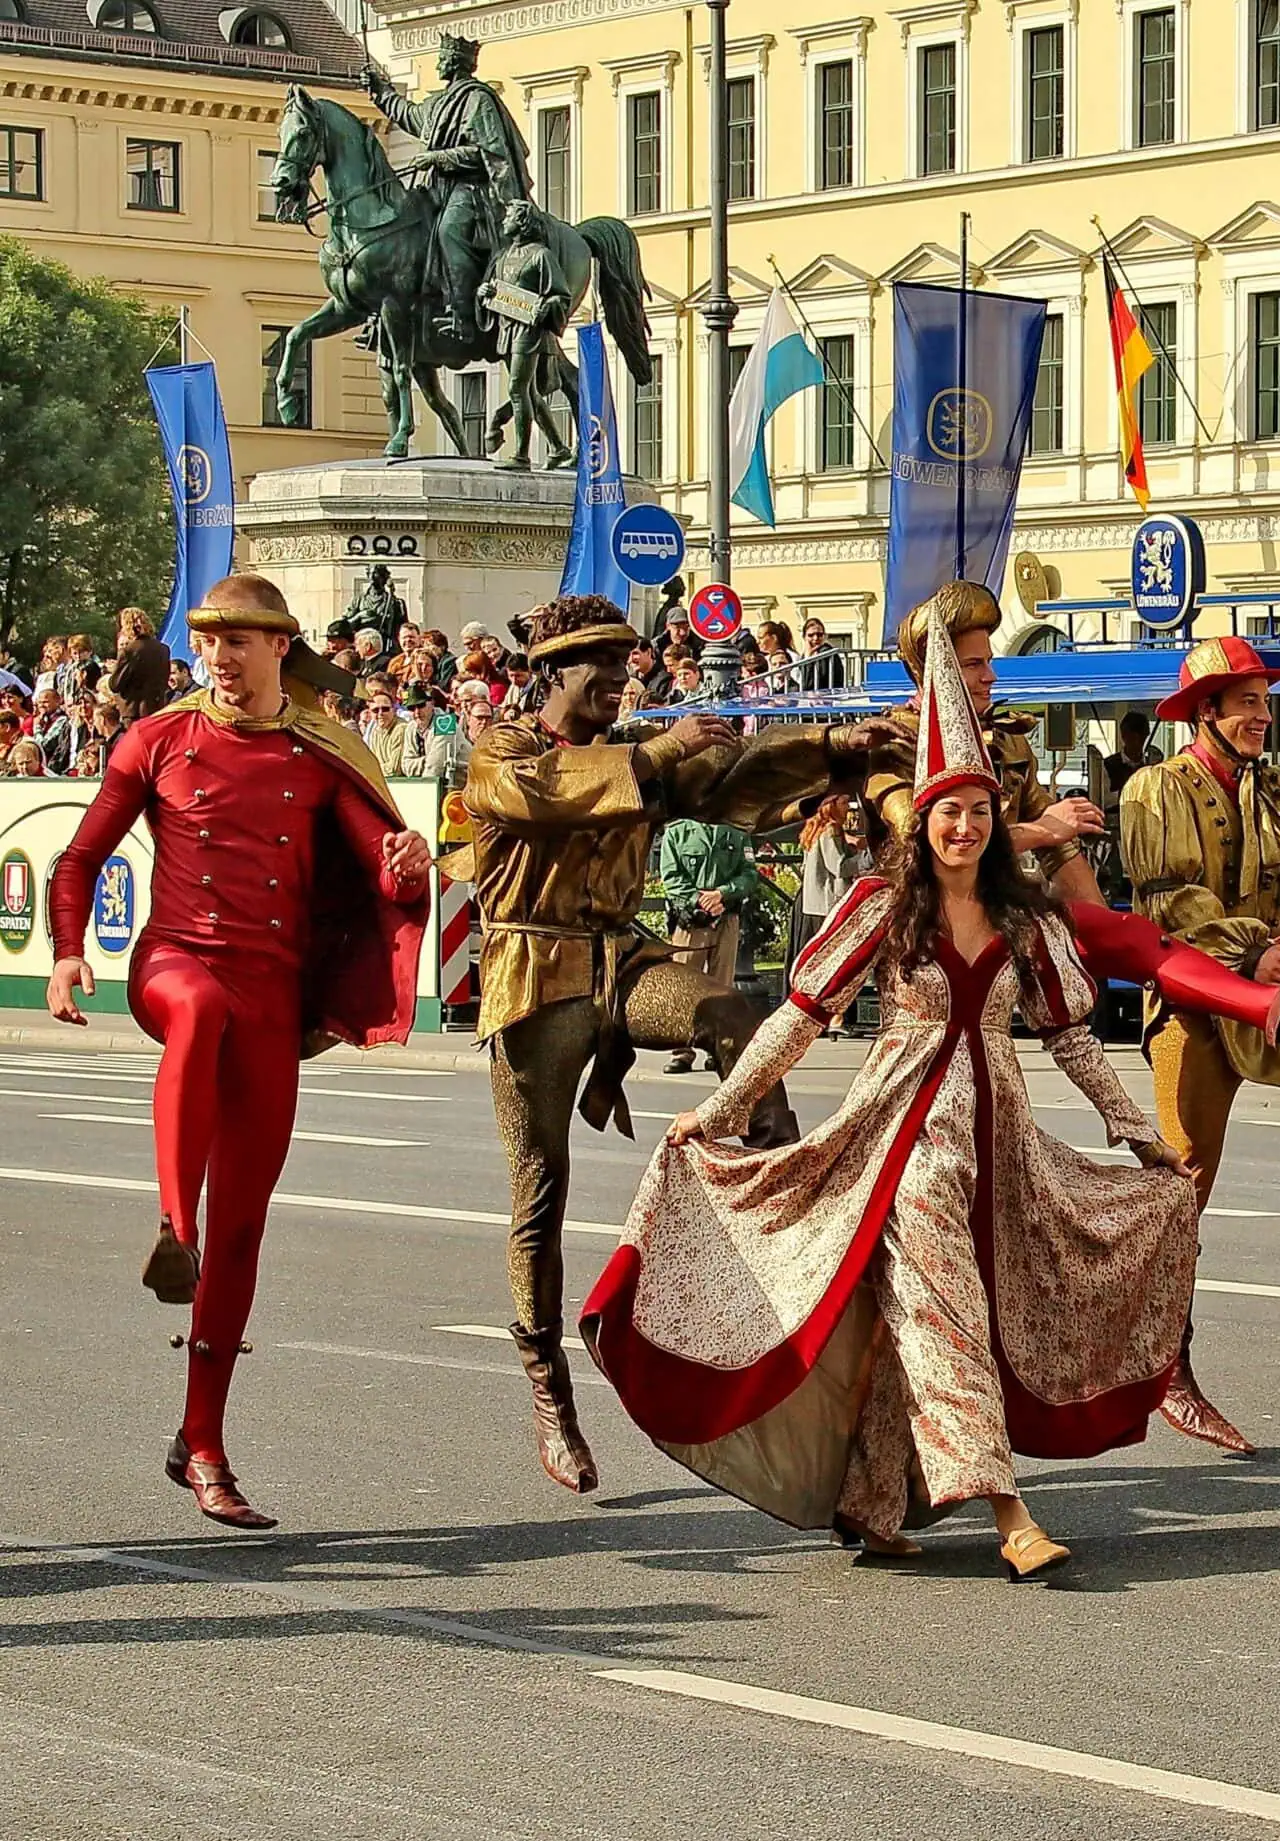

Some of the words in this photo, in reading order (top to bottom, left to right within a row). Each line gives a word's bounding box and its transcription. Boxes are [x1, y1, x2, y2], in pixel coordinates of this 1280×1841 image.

[893, 452, 1016, 491] LÖWENBRÄU
[1136, 593, 1180, 607] LÖWENBRÄU
[0, 917, 31, 930] SPATEN
